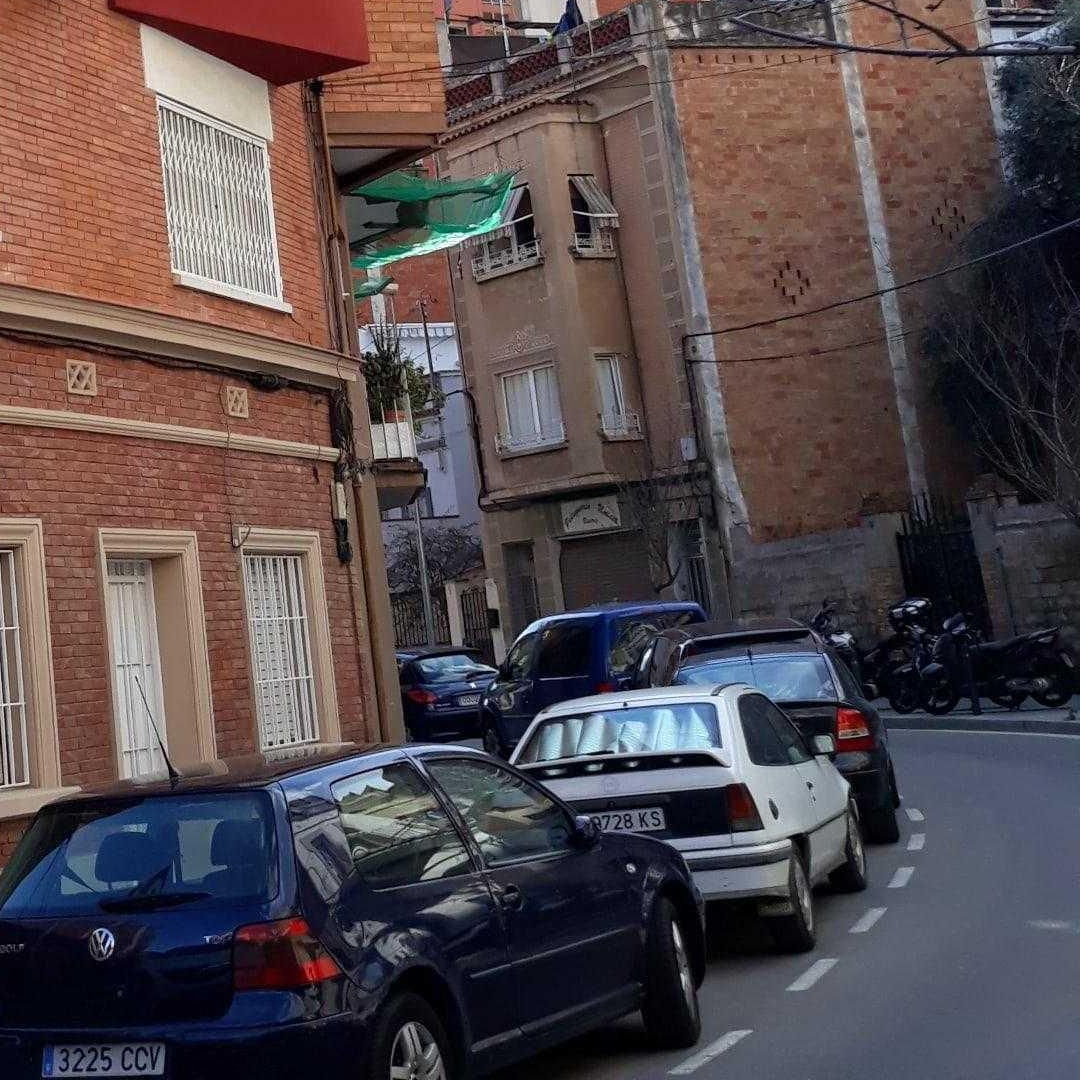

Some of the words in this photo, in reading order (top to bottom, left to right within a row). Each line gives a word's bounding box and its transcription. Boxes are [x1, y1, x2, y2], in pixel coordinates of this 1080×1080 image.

[638, 811, 661, 828] KS
[58, 1046, 113, 1073] 3225
[121, 1045, 162, 1072] CCV
